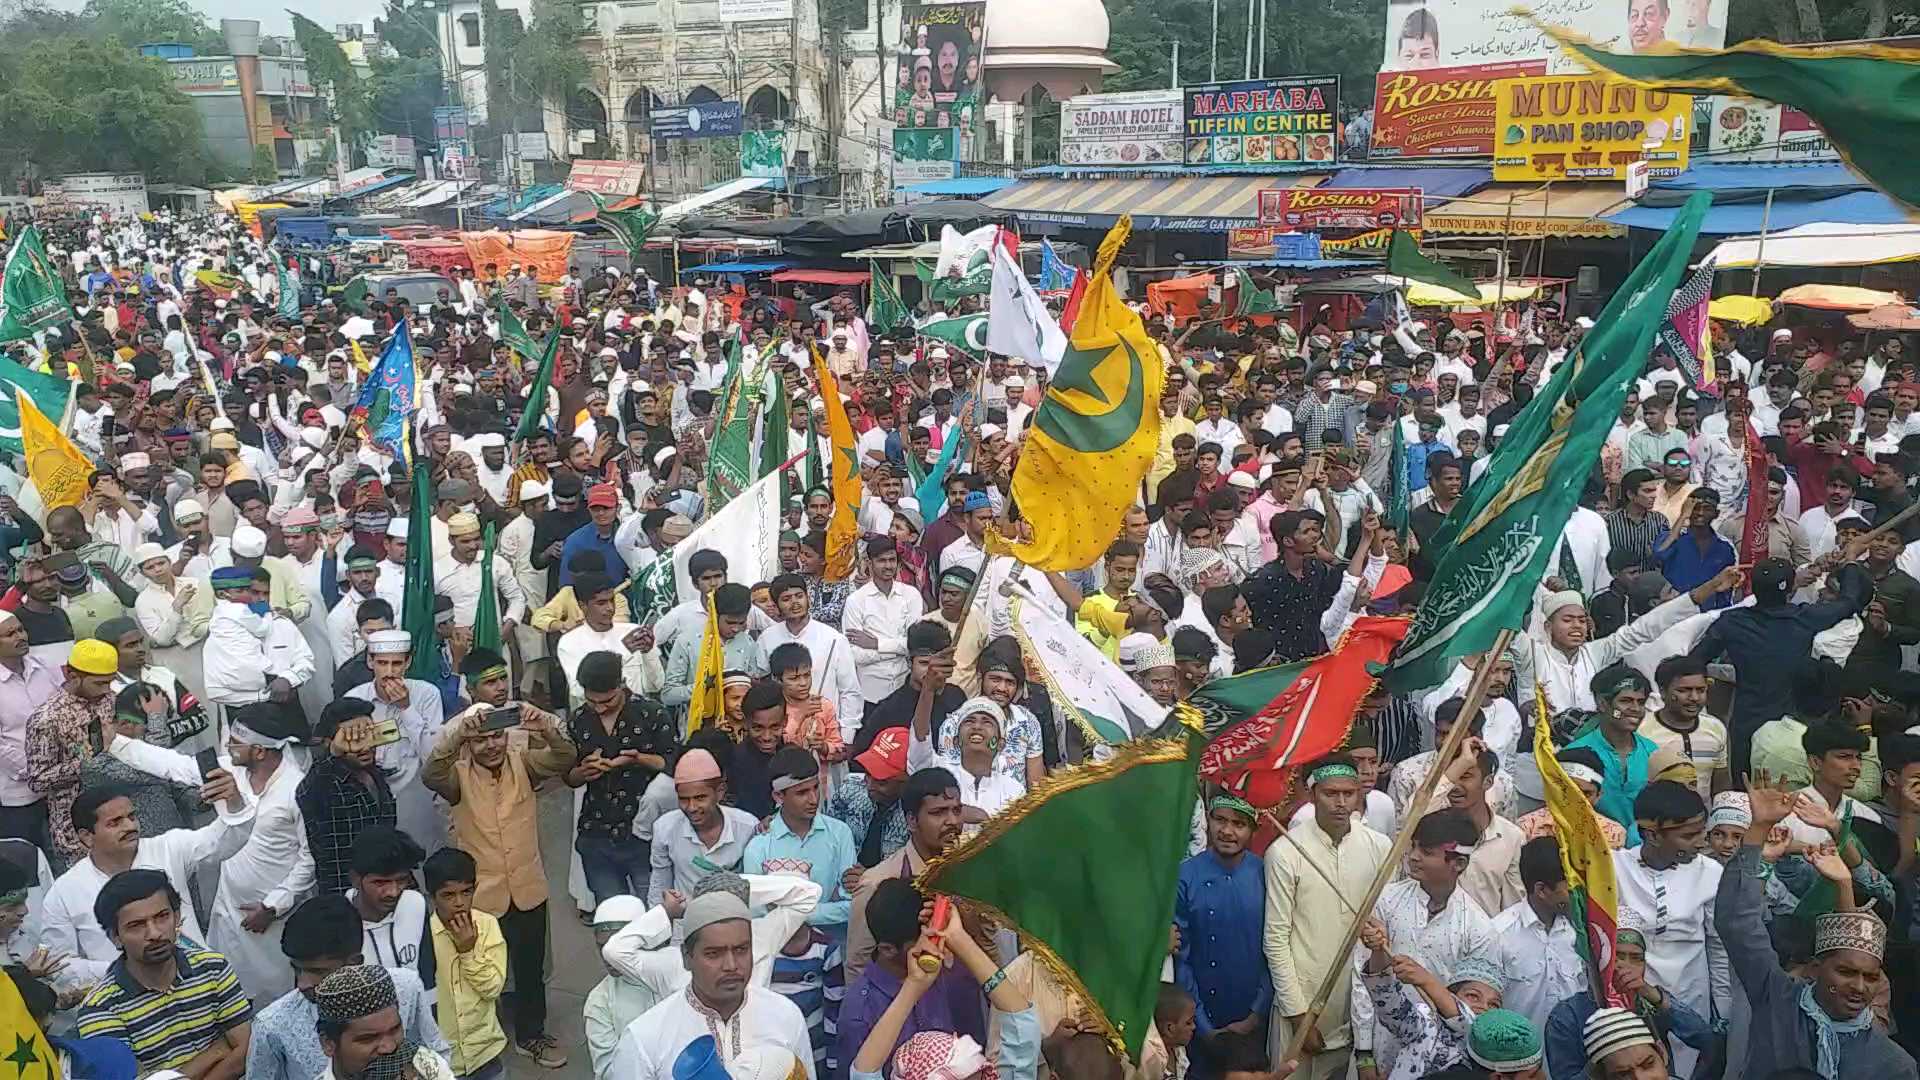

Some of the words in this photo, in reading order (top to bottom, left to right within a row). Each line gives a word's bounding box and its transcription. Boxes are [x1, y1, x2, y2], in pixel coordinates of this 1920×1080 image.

[1193, 87, 1325, 115] MARHABA
[1383, 74, 1496, 114] ROSHA
[1511, 80, 1669, 117] MUNNU
[1075, 110, 1126, 126] SADDAM
[1130, 107, 1174, 124] HOTEL
[1187, 118, 1247, 134] TIFFIN
[1254, 113, 1332, 131] CENTRE
[1407, 111, 1449, 126] Sweet
[1078, 127, 1097, 135] FAMILY
[1122, 125, 1136, 134] ALSO
[1137, 123, 1168, 133] AVAILABLE
[1405, 130, 1443, 146] Chicken
[1448, 124, 1496, 136] Shawarm
[1532, 122, 1574, 143] PAN
[1581, 120, 1645, 141] SHOP
[1288, 191, 1381, 208] ROSHAN
[1209, 219, 1256, 229] GARMEN
[1429, 218, 1470, 228] MUNNU
[1474, 219, 1498, 229] PAN
[1499, 219, 1532, 231] SHOP
